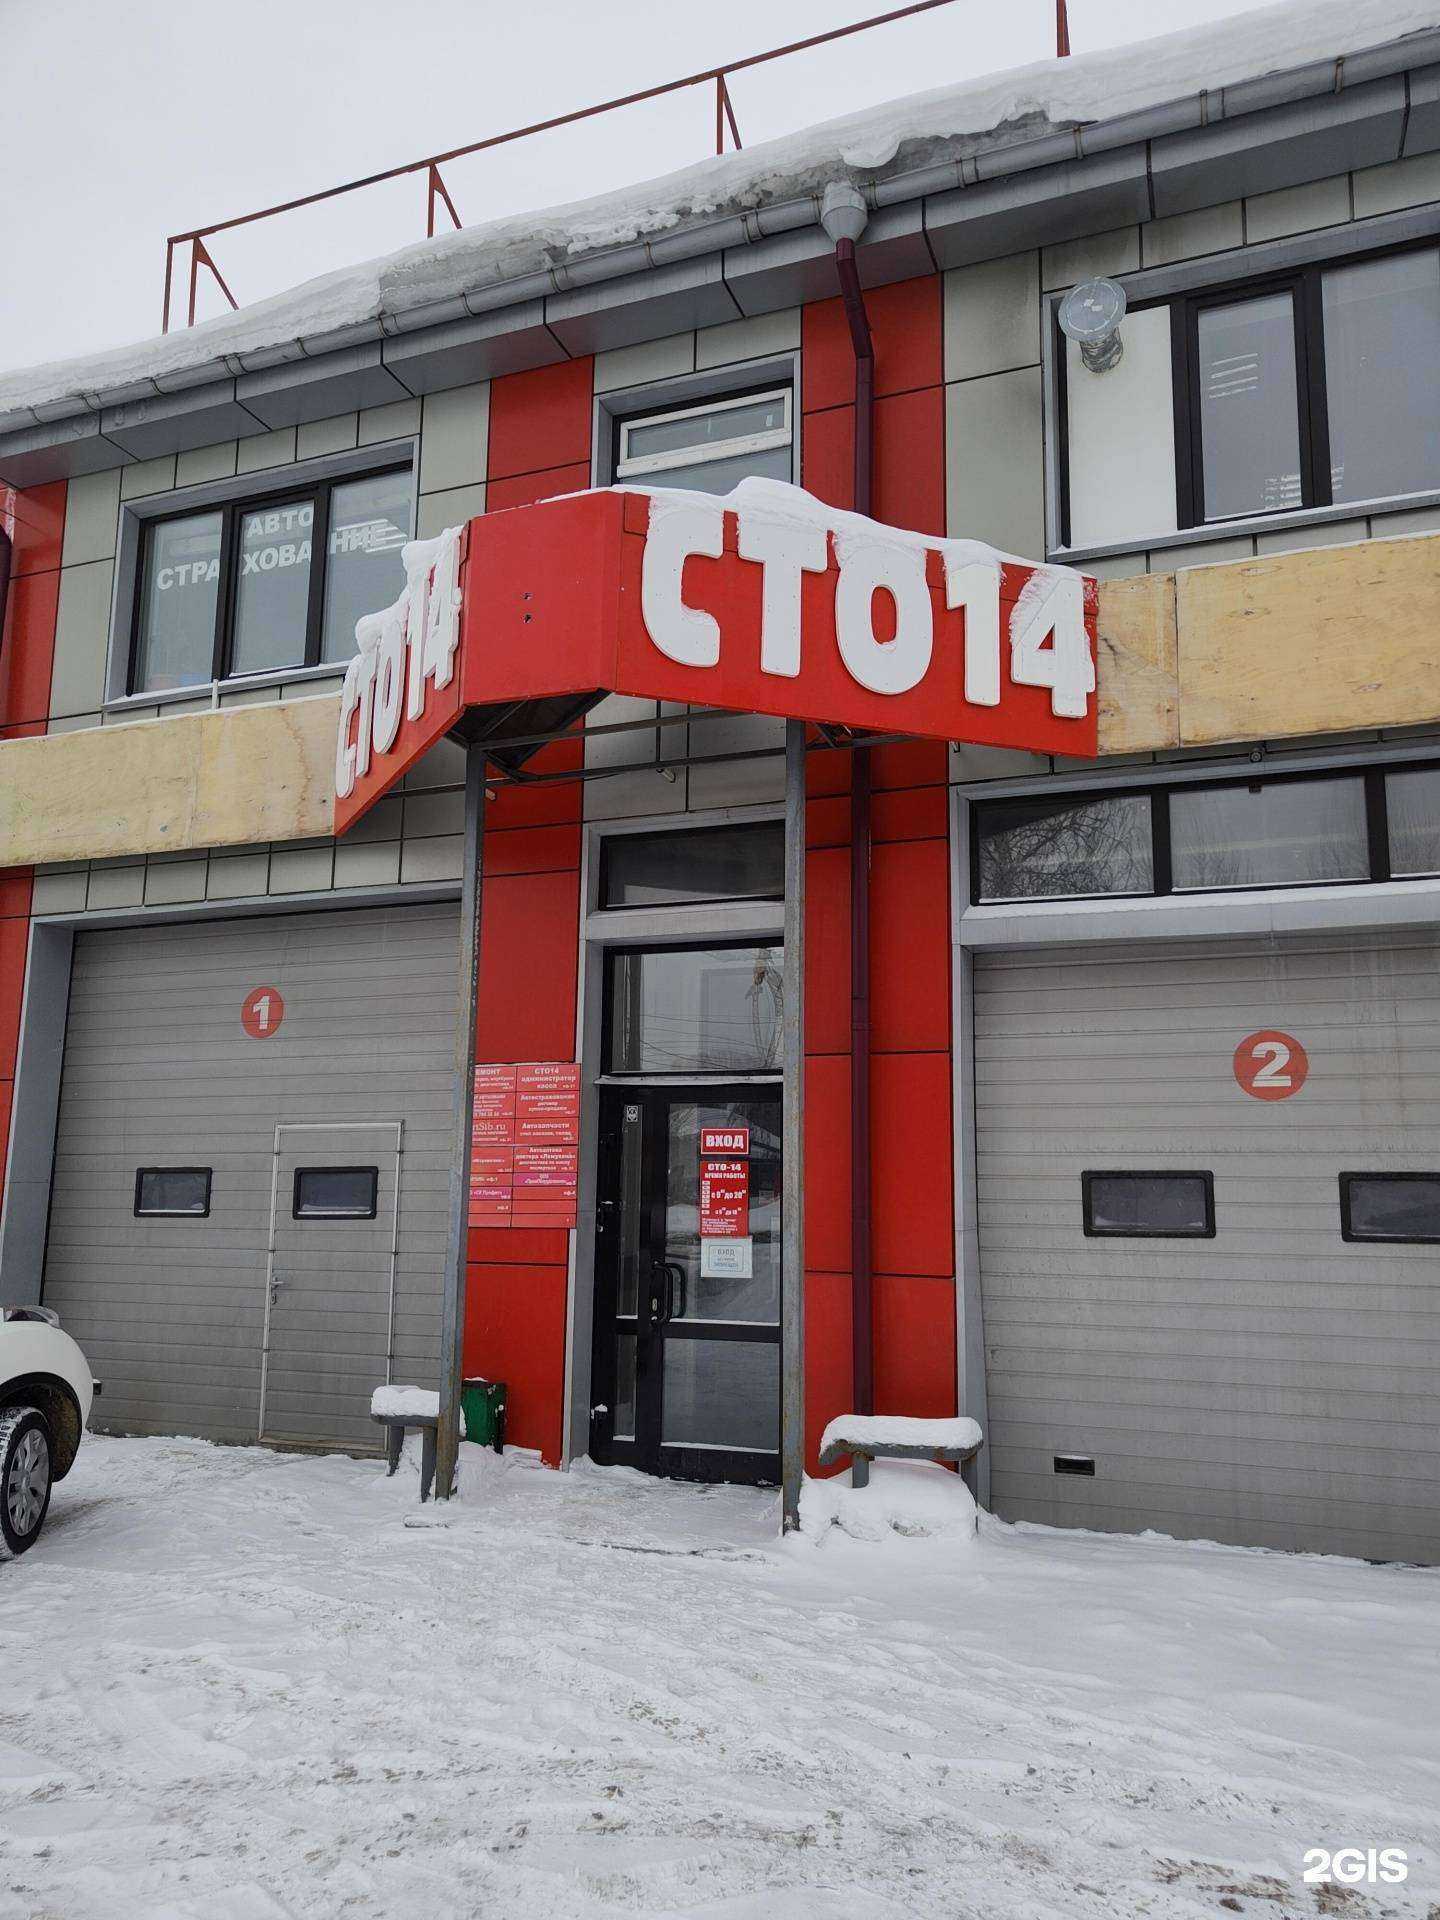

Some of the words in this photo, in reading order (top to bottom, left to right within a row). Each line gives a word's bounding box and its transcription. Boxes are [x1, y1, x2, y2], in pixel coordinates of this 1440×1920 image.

[247, 506, 314, 538] АВТО
[157, 559, 220, 590] СТРА
[242, 541, 312, 575] ХОВА
[641, 505, 1096, 718] СТО14
[335, 532, 461, 799] СТО14
[253, 996, 270, 1029] 1
[1251, 1042, 1291, 1087] 2
[472, 1121, 506, 1131] nSib.ru
[705, 1135, 744, 1149] ВХОД
[707, 1163, 742, 1171] СТО-14
